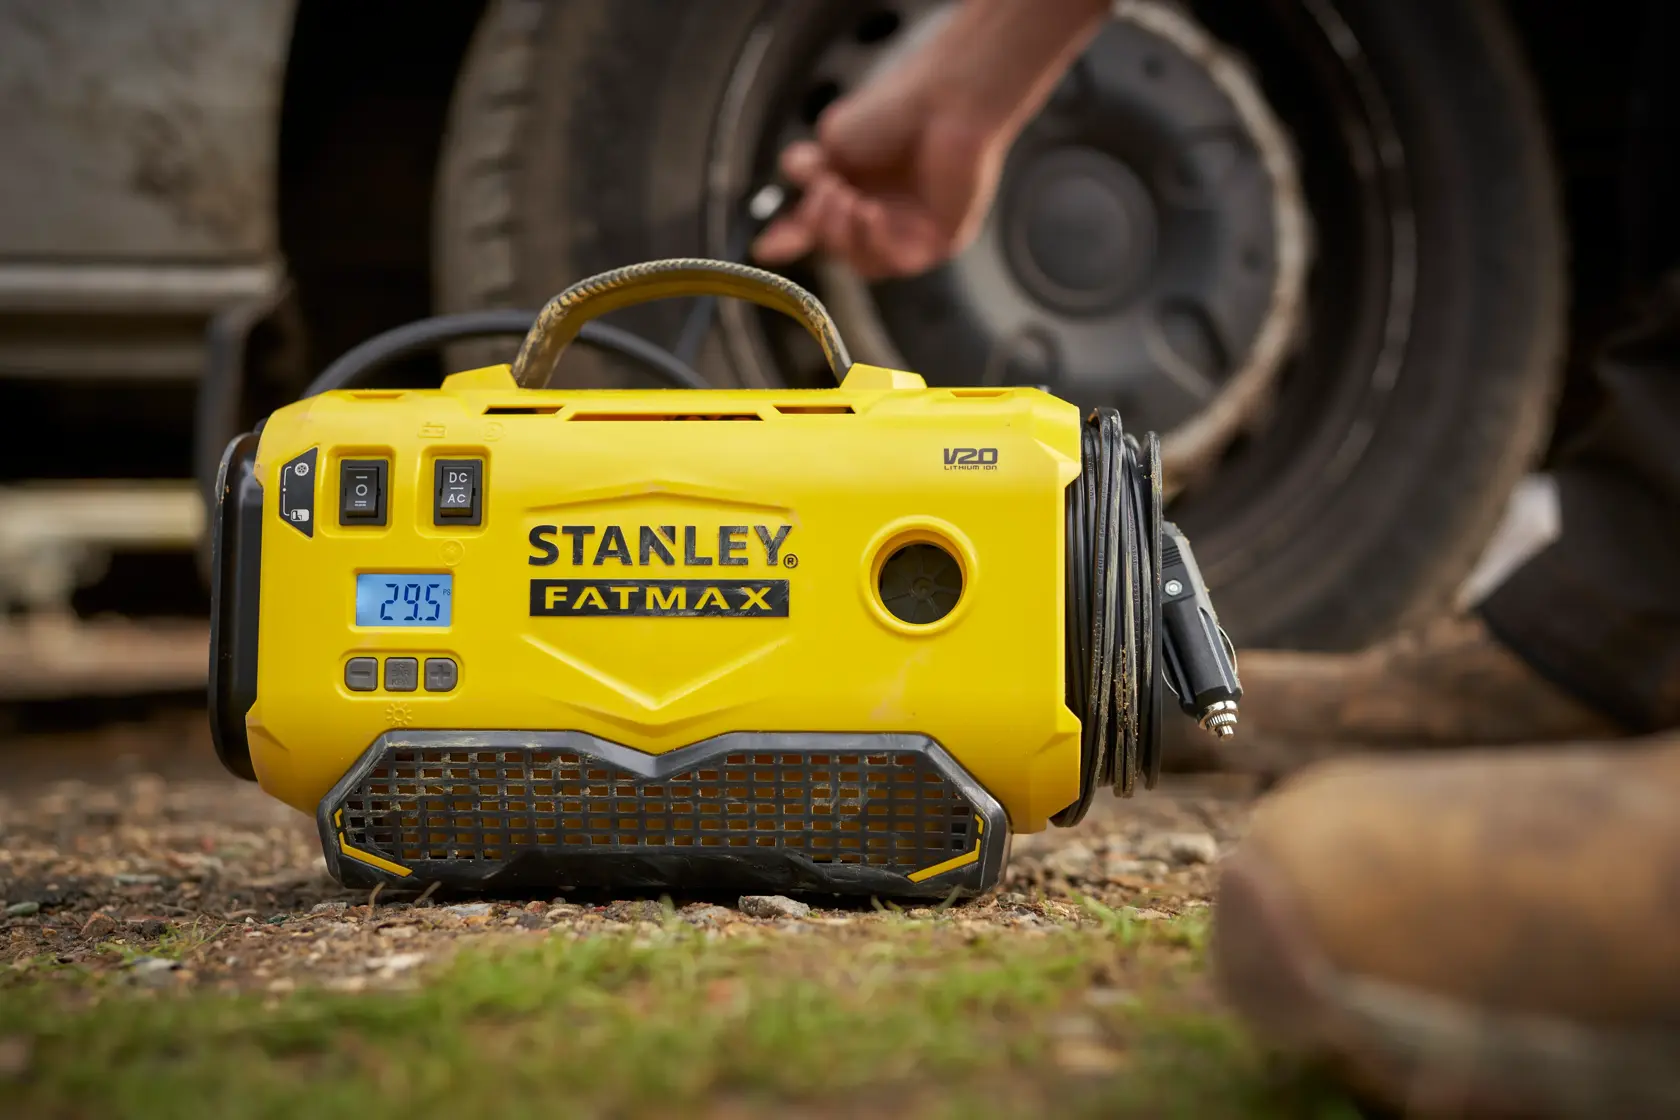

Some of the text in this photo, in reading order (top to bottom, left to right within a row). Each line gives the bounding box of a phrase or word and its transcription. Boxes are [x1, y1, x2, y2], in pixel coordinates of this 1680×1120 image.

[944, 448, 998, 464] V20
[449, 471, 468, 483] DC
[447, 493, 466, 503] AC
[380, 584, 440, 621] 29.5
[544, 587, 773, 610] FATMAX
